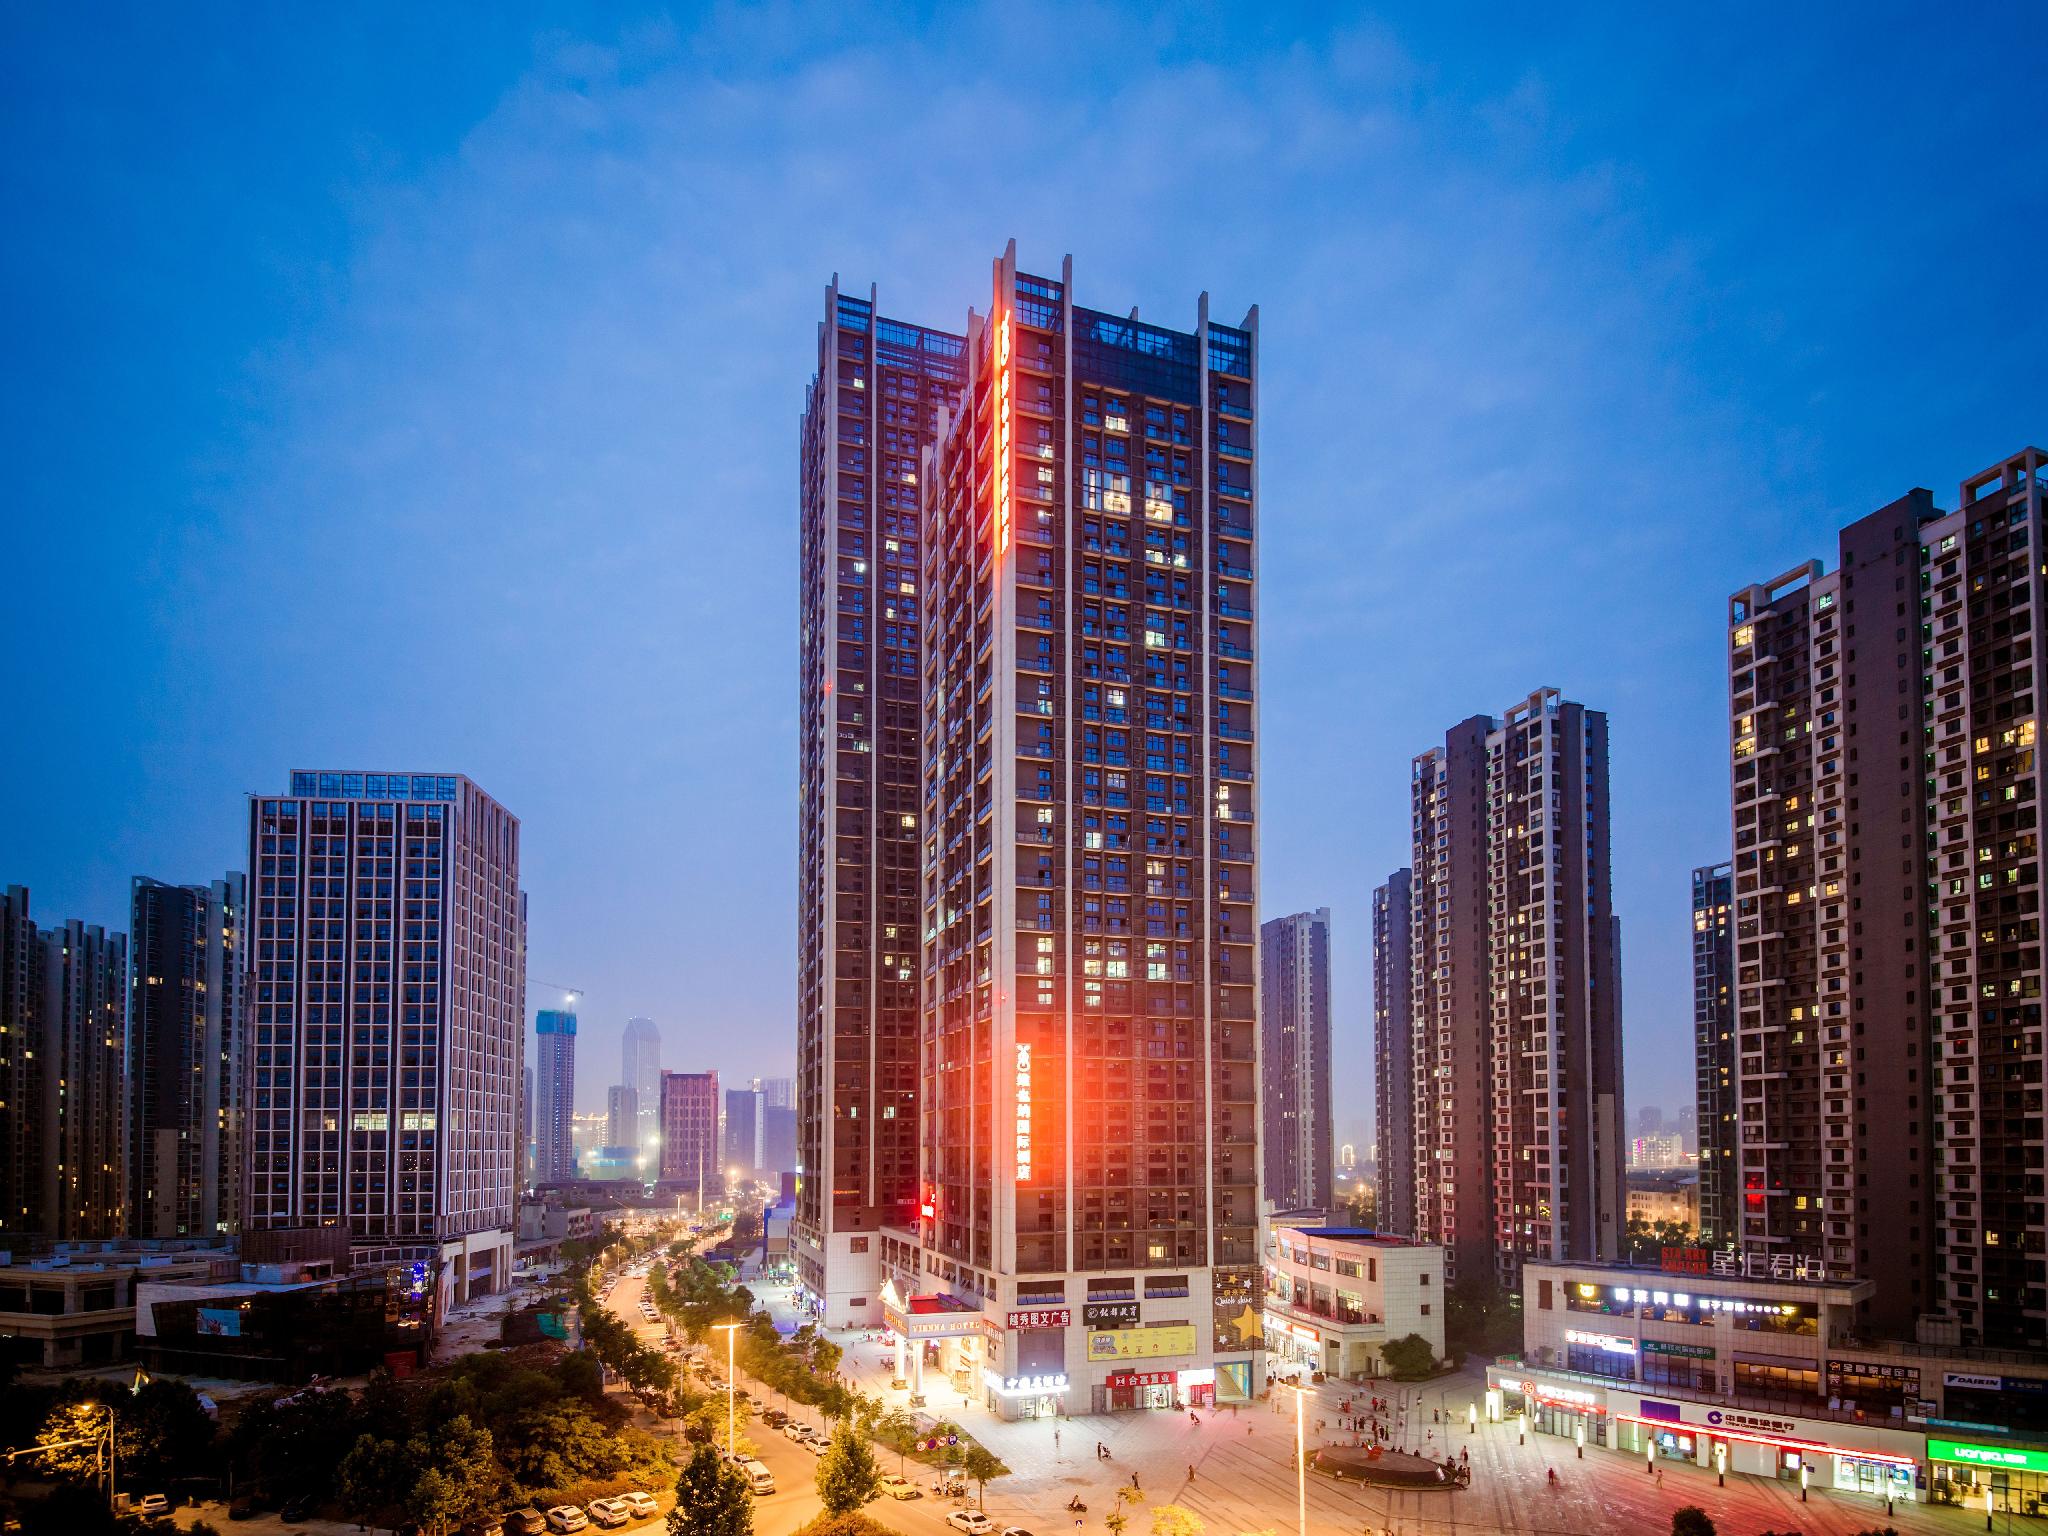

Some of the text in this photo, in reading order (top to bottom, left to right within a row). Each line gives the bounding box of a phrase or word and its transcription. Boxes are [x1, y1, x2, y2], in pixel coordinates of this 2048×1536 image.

[1712, 1250, 1825, 1282] 星汇君泊
[1009, 1310, 1070, 1326] 越秀图文广告
[912, 1323, 946, 1333] VIENNA
[950, 1321, 980, 1331] HOTEL
[1957, 1377, 1999, 1386] DAIKIN
